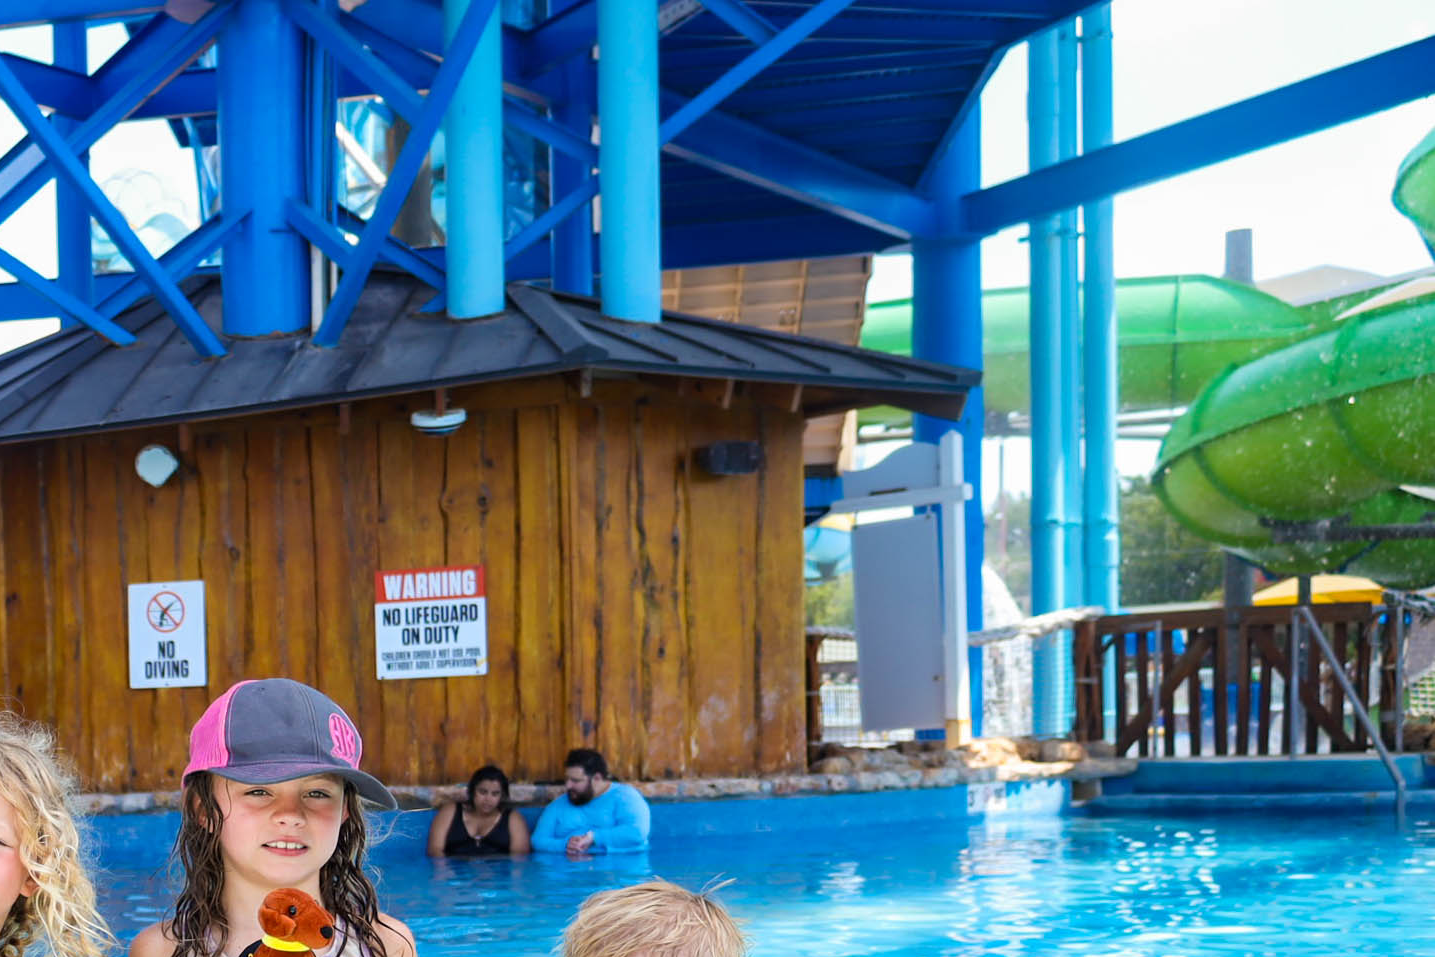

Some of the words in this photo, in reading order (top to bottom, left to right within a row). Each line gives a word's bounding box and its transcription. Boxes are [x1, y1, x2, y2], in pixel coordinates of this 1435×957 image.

[383, 569, 476, 601] WARNING
[382, 608, 401, 626] NO
[405, 604, 478, 625] LIFEGUARD
[402, 627, 420, 645] ON
[424, 625, 459, 644] DUTY
[158, 640, 175, 659] NO
[145, 659, 189, 679] DIVING
